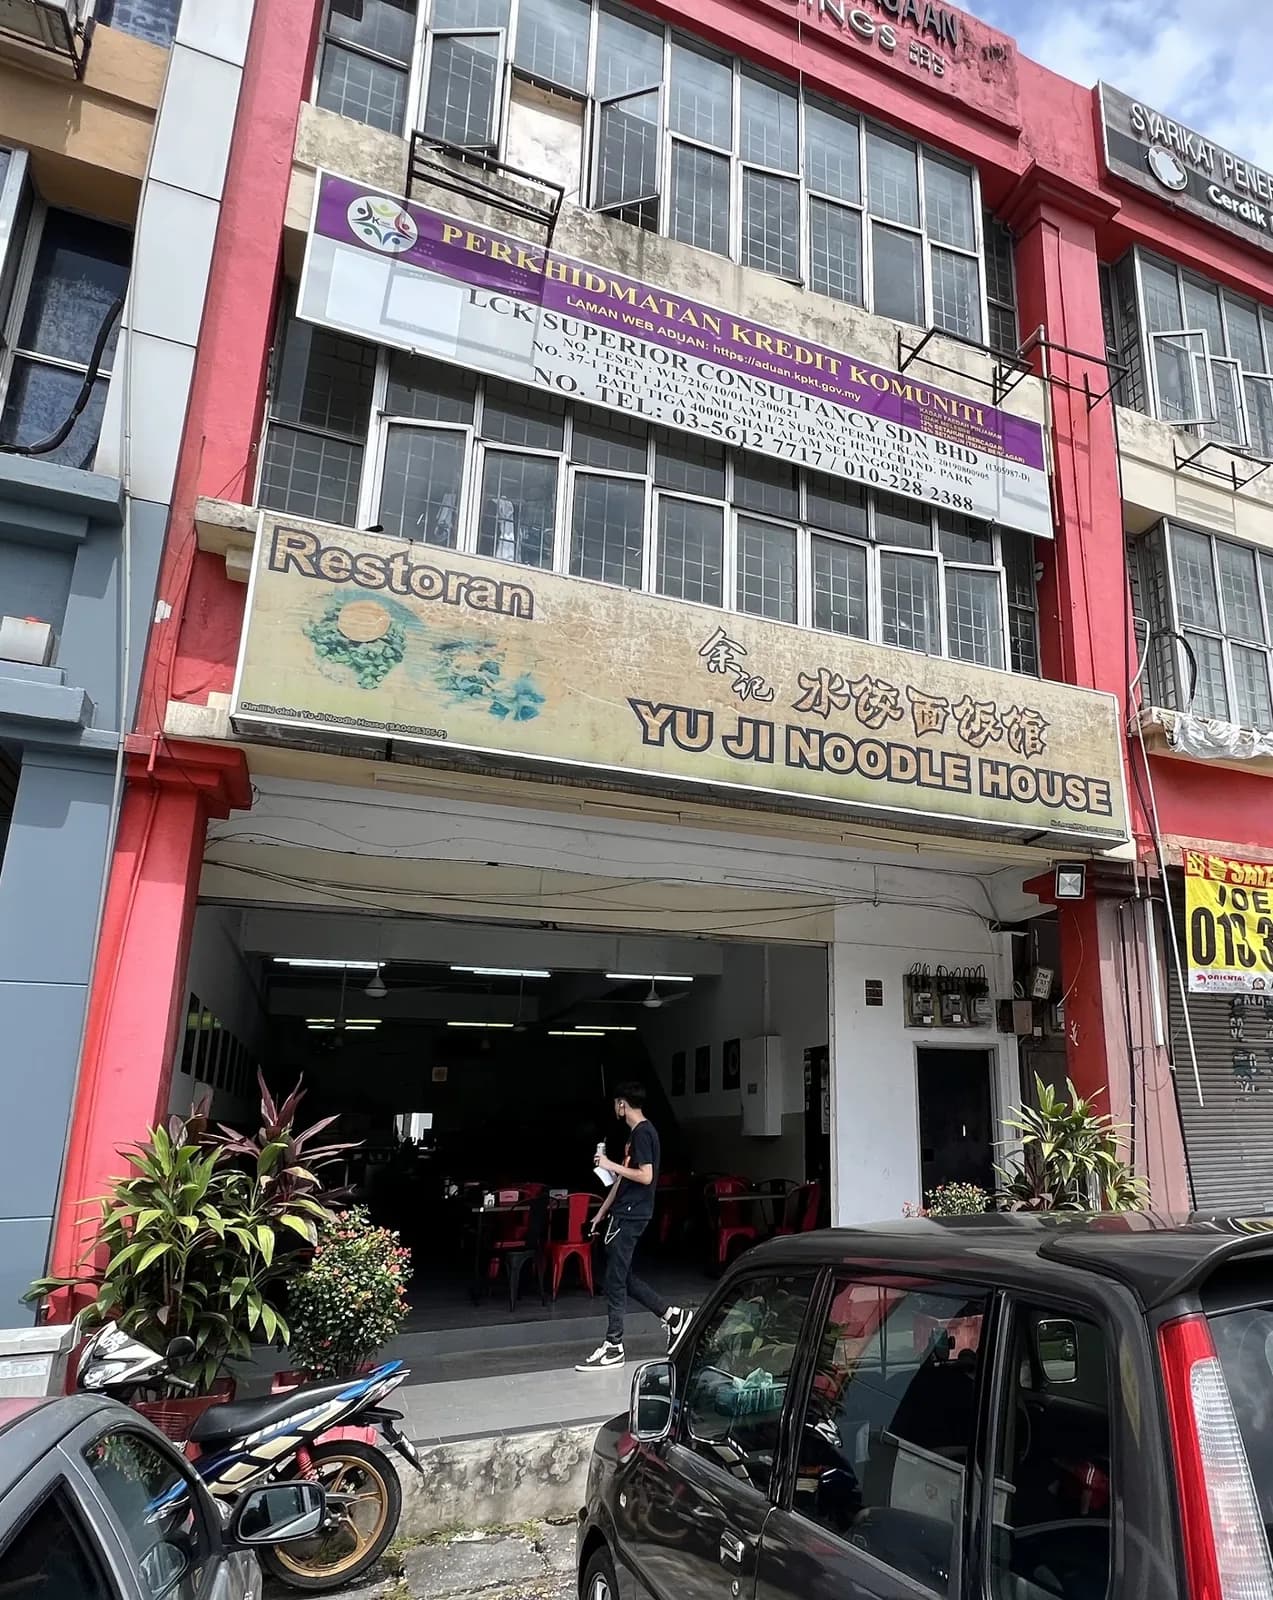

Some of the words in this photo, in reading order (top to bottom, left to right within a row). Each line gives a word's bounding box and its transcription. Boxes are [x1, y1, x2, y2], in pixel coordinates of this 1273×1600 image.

[909, 52, 945, 76] BHD
[910, 41, 945, 65] SDN
[1131, 103, 1215, 170] SYARIKAT
[1207, 185, 1267, 228] Cerdik
[441, 223, 722, 336] PERKHIDMATAN
[731, 323, 842, 376] KREDIT
[849, 365, 984, 426] KOMUNITI
[468, 288, 535, 324] LCK
[543, 312, 689, 373] SUPERIOR
[696, 363, 879, 433] CONSULTANCY
[885, 424, 927, 449] SDN
[935, 440, 978, 465] BHD
[566, 295, 618, 320] LAMAN
[622, 314, 654, 331] WEB
[657, 326, 709, 350] ADUAN:
[713, 343, 861, 402] https://aduan.kpkt.gov.my
[533, 340, 562, 358] NO.
[567, 352, 597, 368] 37-1
[602, 361, 638, 381] TKT
[654, 379, 706, 401] JALAN
[711, 396, 761, 419] NILAM
[767, 414, 785, 427] 1/2
[788, 420, 846, 446] SUBANG
[850, 440, 906, 465] HI-TECH
[910, 459, 937, 474] IND.
[940, 468, 973, 486] PARK
[534, 366, 585, 396] NO.
[595, 385, 662, 418] TEL:
[672, 408, 763, 448] 03-5612
[772, 439, 822, 465] 7717
[844, 460, 922, 496] 010-228
[930, 486, 974, 511] 2388
[563, 338, 590, 354] NO.
[595, 347, 643, 370] LESEN
[816, 417, 837, 432] NO.
[841, 426, 886, 447] PERMIT
[892, 441, 930, 461] IKLAN
[598, 373, 641, 393] BATU
[647, 388, 686, 408] TIGA
[690, 402, 729, 421] 40000
[733, 414, 774, 435] SHAH
[779, 430, 821, 449] ALAM
[825, 443, 900, 473] SELANGOR
[904, 466, 928, 482] D.E.
[268, 525, 535, 620] Restoran
[241, 701, 275, 714] Dimiliki
[302, 710, 314, 719] Yu
[324, 713, 357, 726] Noodle
[357, 717, 386, 729] House
[627, 697, 714, 752] YU
[721, 716, 774, 763] JI
[785, 724, 971, 794] NOODLE
[978, 758, 1112, 816] HOUSE
[1214, 885, 1271, 914] JOE
